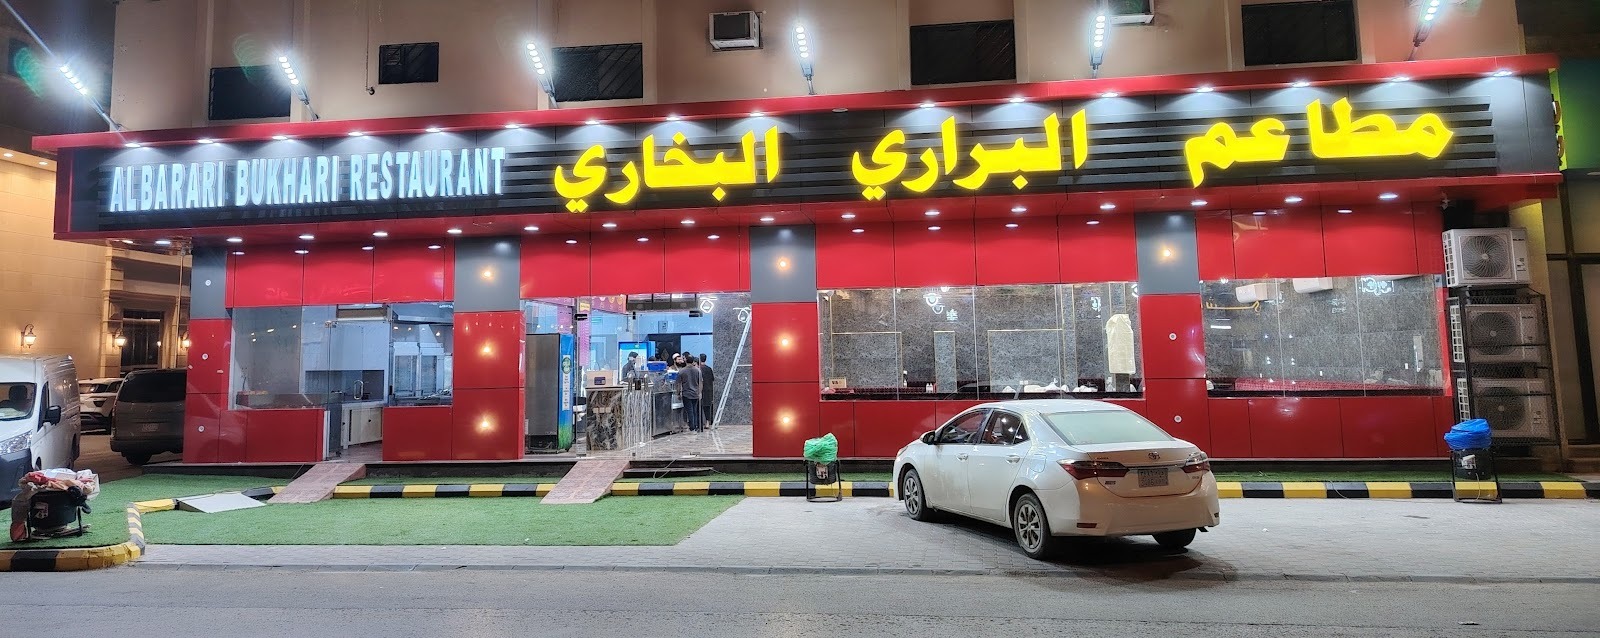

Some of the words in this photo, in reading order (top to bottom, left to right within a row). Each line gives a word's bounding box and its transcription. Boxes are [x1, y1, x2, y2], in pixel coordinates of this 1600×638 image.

[109, 161, 227, 212] ALBARARI
[235, 156, 340, 207] BUKHARI
[350, 147, 506, 201] RESTAURANT
[553, 126, 780, 213] البخاري
[851, 108, 1090, 200] البراري
[1184, 97, 1454, 189] مطاعم
